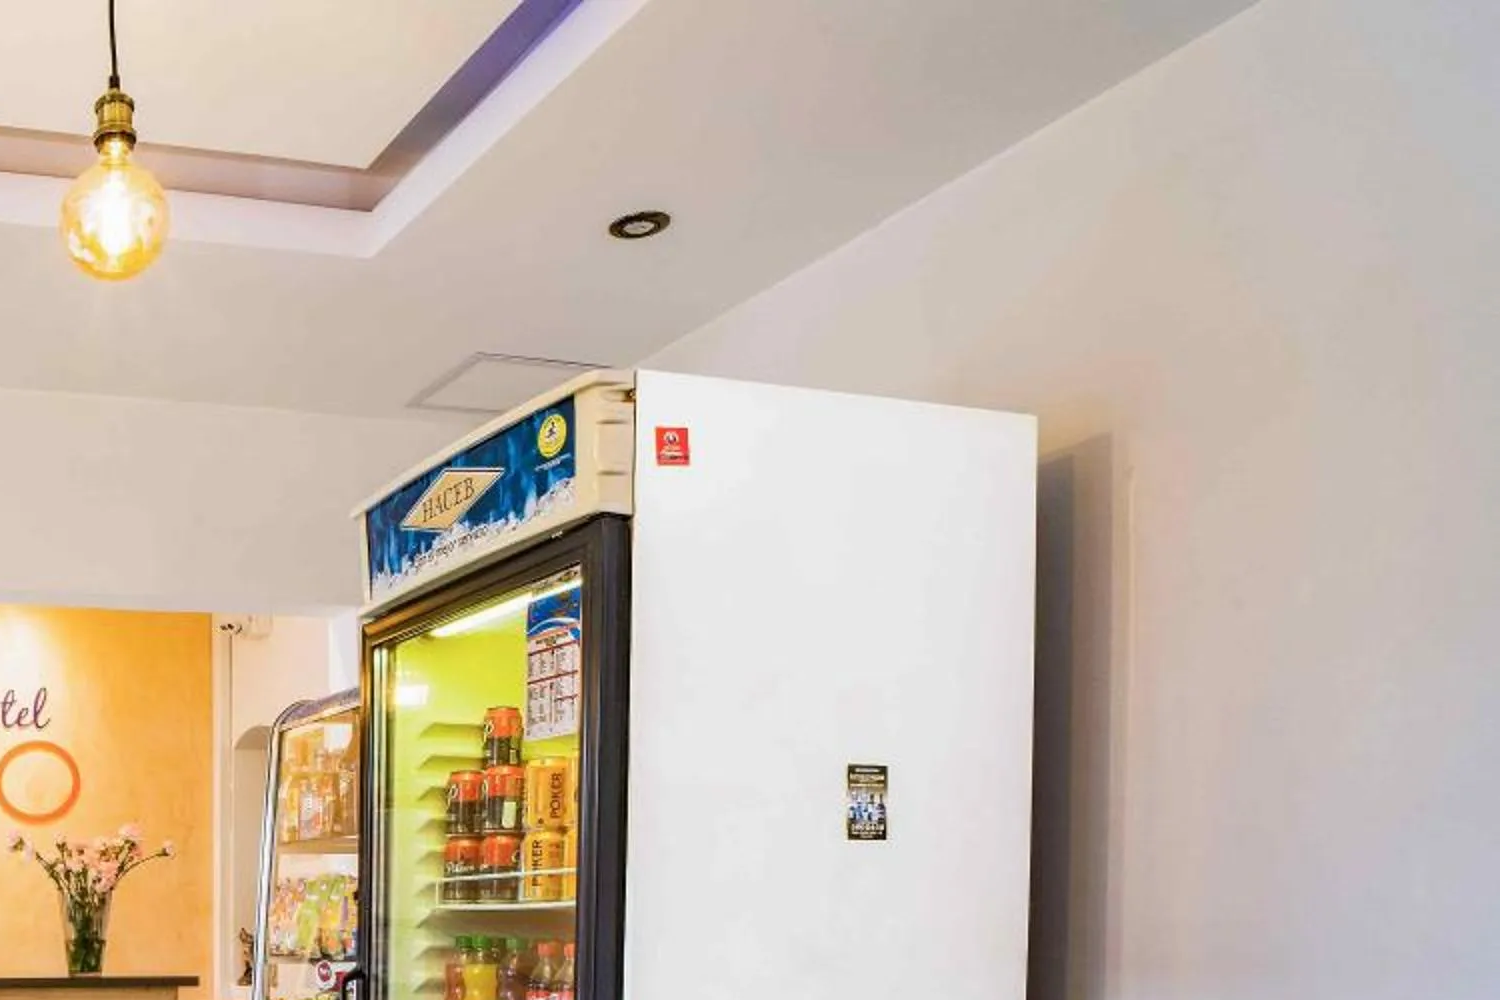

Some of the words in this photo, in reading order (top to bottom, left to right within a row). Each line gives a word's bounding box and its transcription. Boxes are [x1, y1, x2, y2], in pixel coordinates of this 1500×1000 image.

[422, 476, 475, 523] HACEB
[550, 772, 563, 819] POKER
[532, 839, 543, 887] PKER
